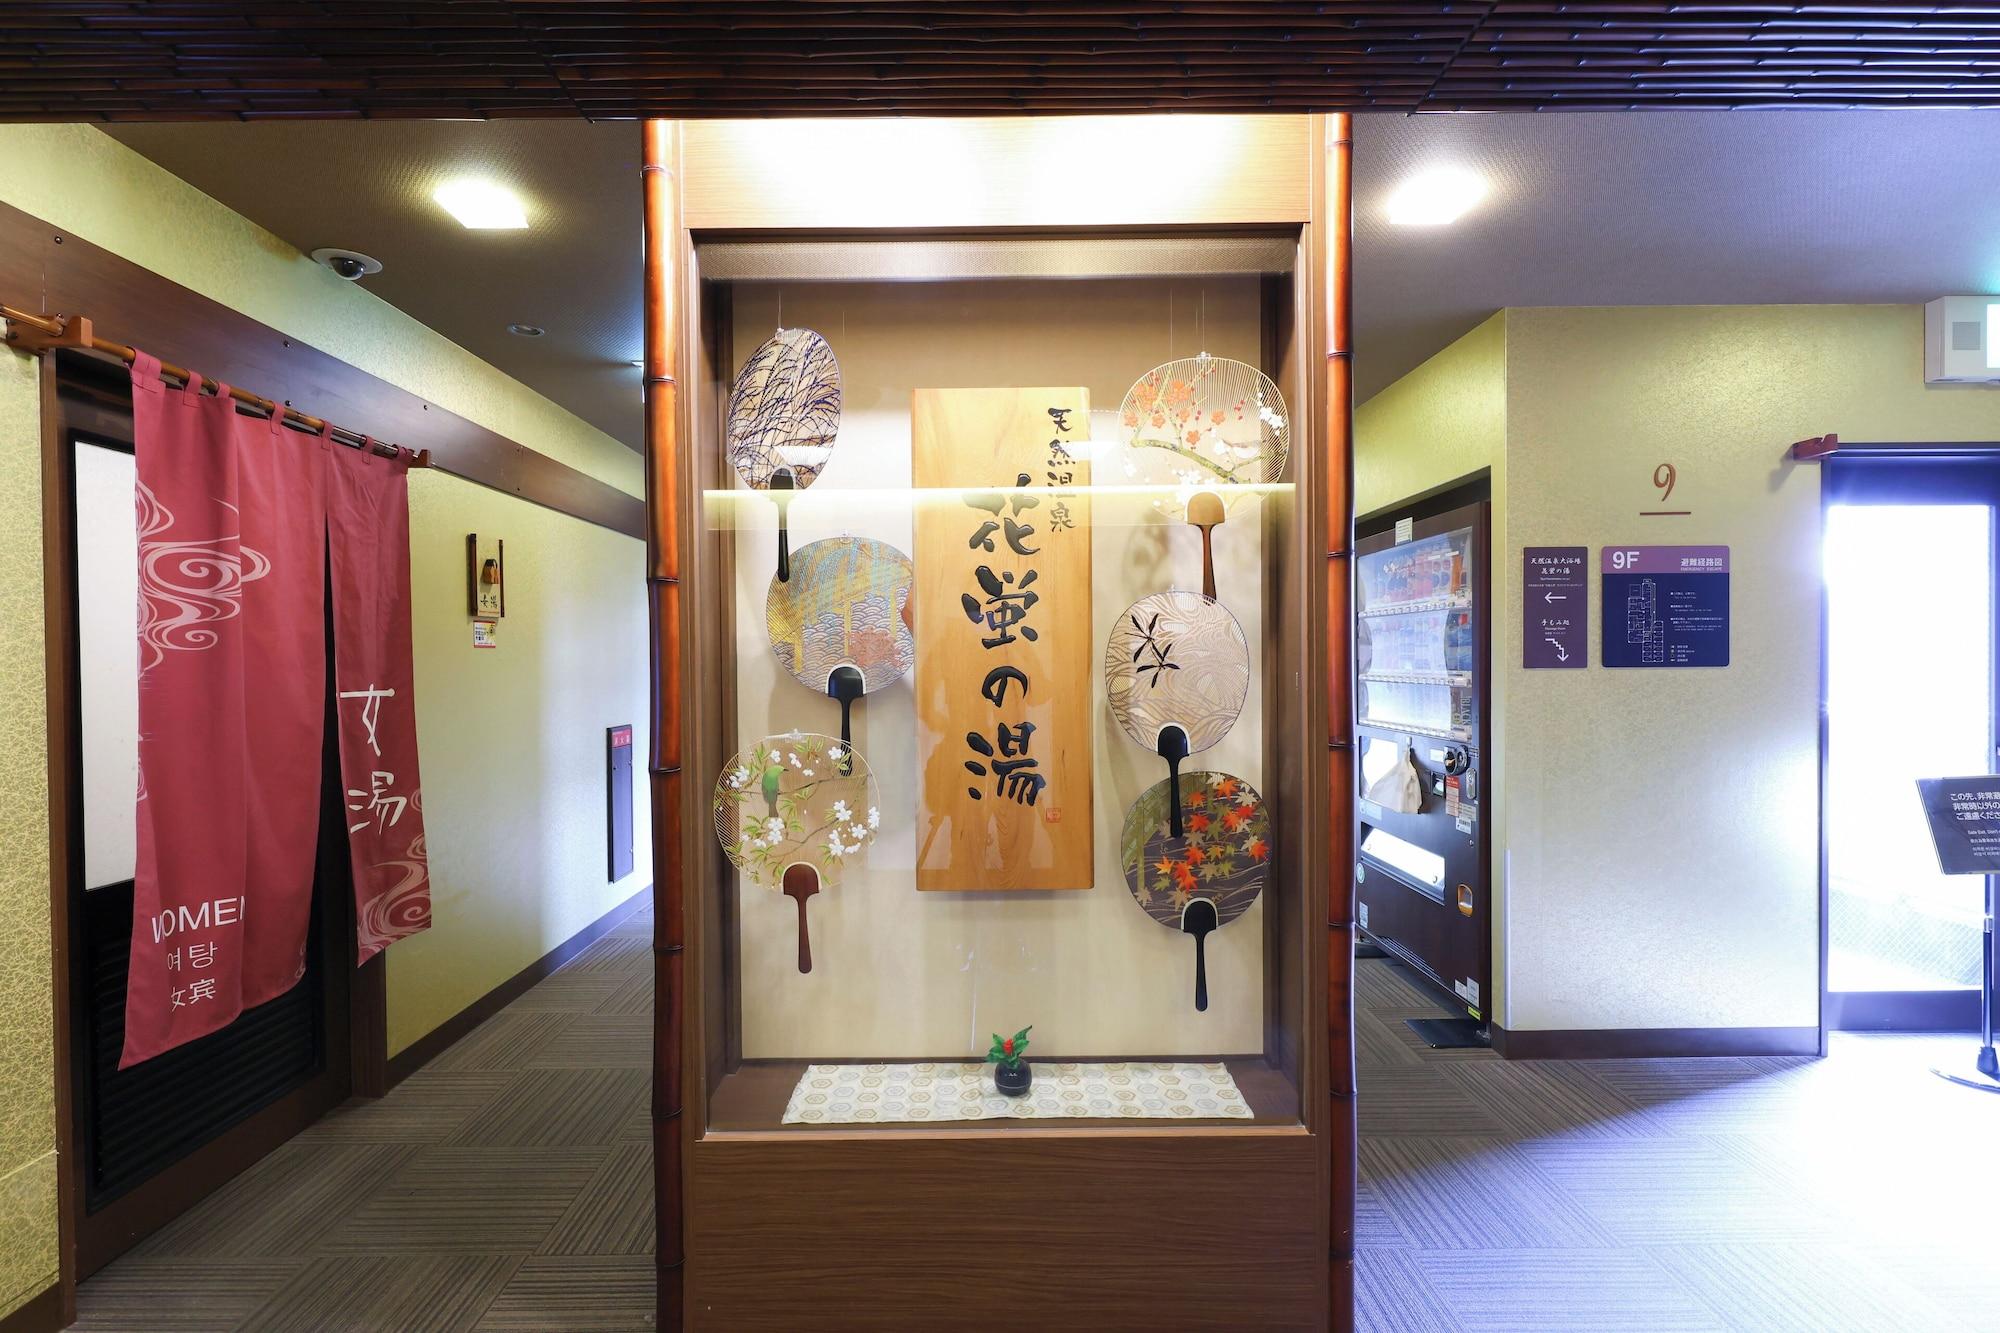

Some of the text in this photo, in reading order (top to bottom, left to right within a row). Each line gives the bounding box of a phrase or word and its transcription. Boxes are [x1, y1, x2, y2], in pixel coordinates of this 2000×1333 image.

[1047, 407, 1076, 533] 天然温泉
[1653, 463, 1676, 502] 9
[1612, 551, 1640, 569] 9F
[961, 473, 1047, 807] 花蛍の湯
[339, 683, 408, 835] 女湯
[167, 941, 218, 972] 여탕
[170, 978, 216, 1012] 女宾
